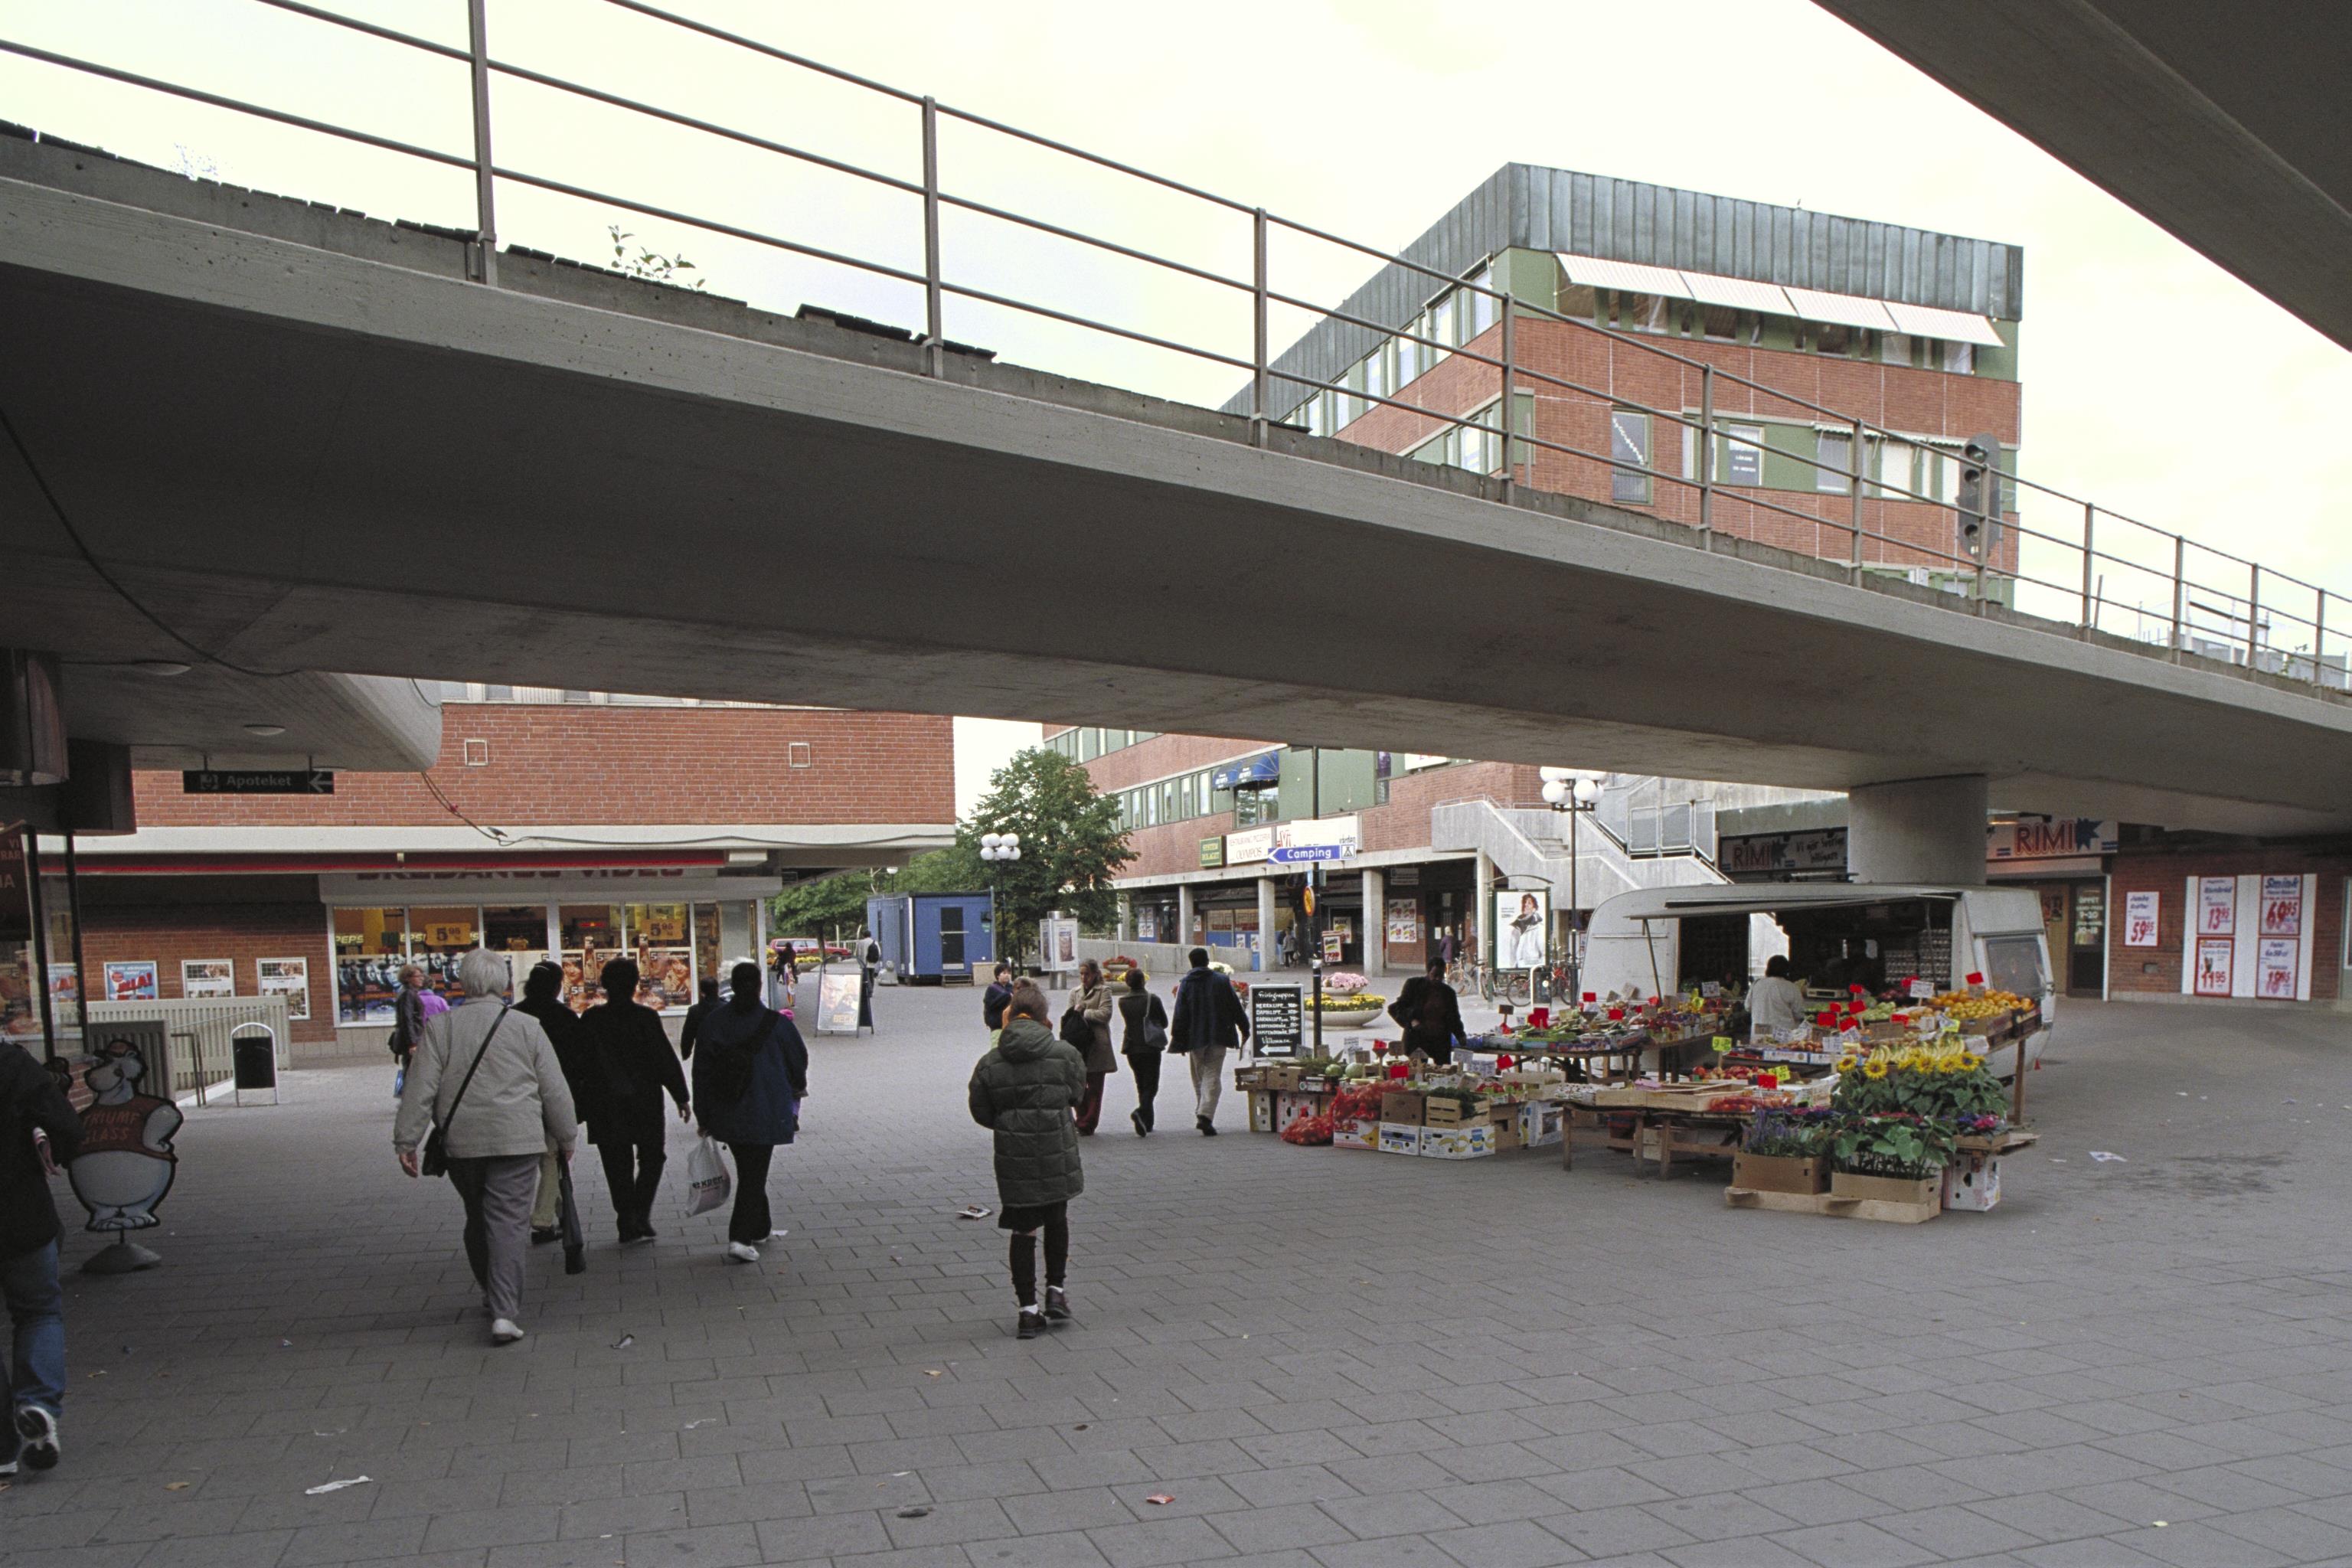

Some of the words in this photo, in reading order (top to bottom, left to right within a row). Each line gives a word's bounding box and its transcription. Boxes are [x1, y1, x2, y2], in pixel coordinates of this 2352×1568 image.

[227, 775, 292, 789] Apoteket
[2016, 821, 2076, 854] RIMI
[1236, 847, 1262, 860] OLYMPOS
[1287, 848, 1331, 860] Camping
[1733, 844, 1770, 868] RIMI
[82, 1111, 141, 1126] TRIUMF
